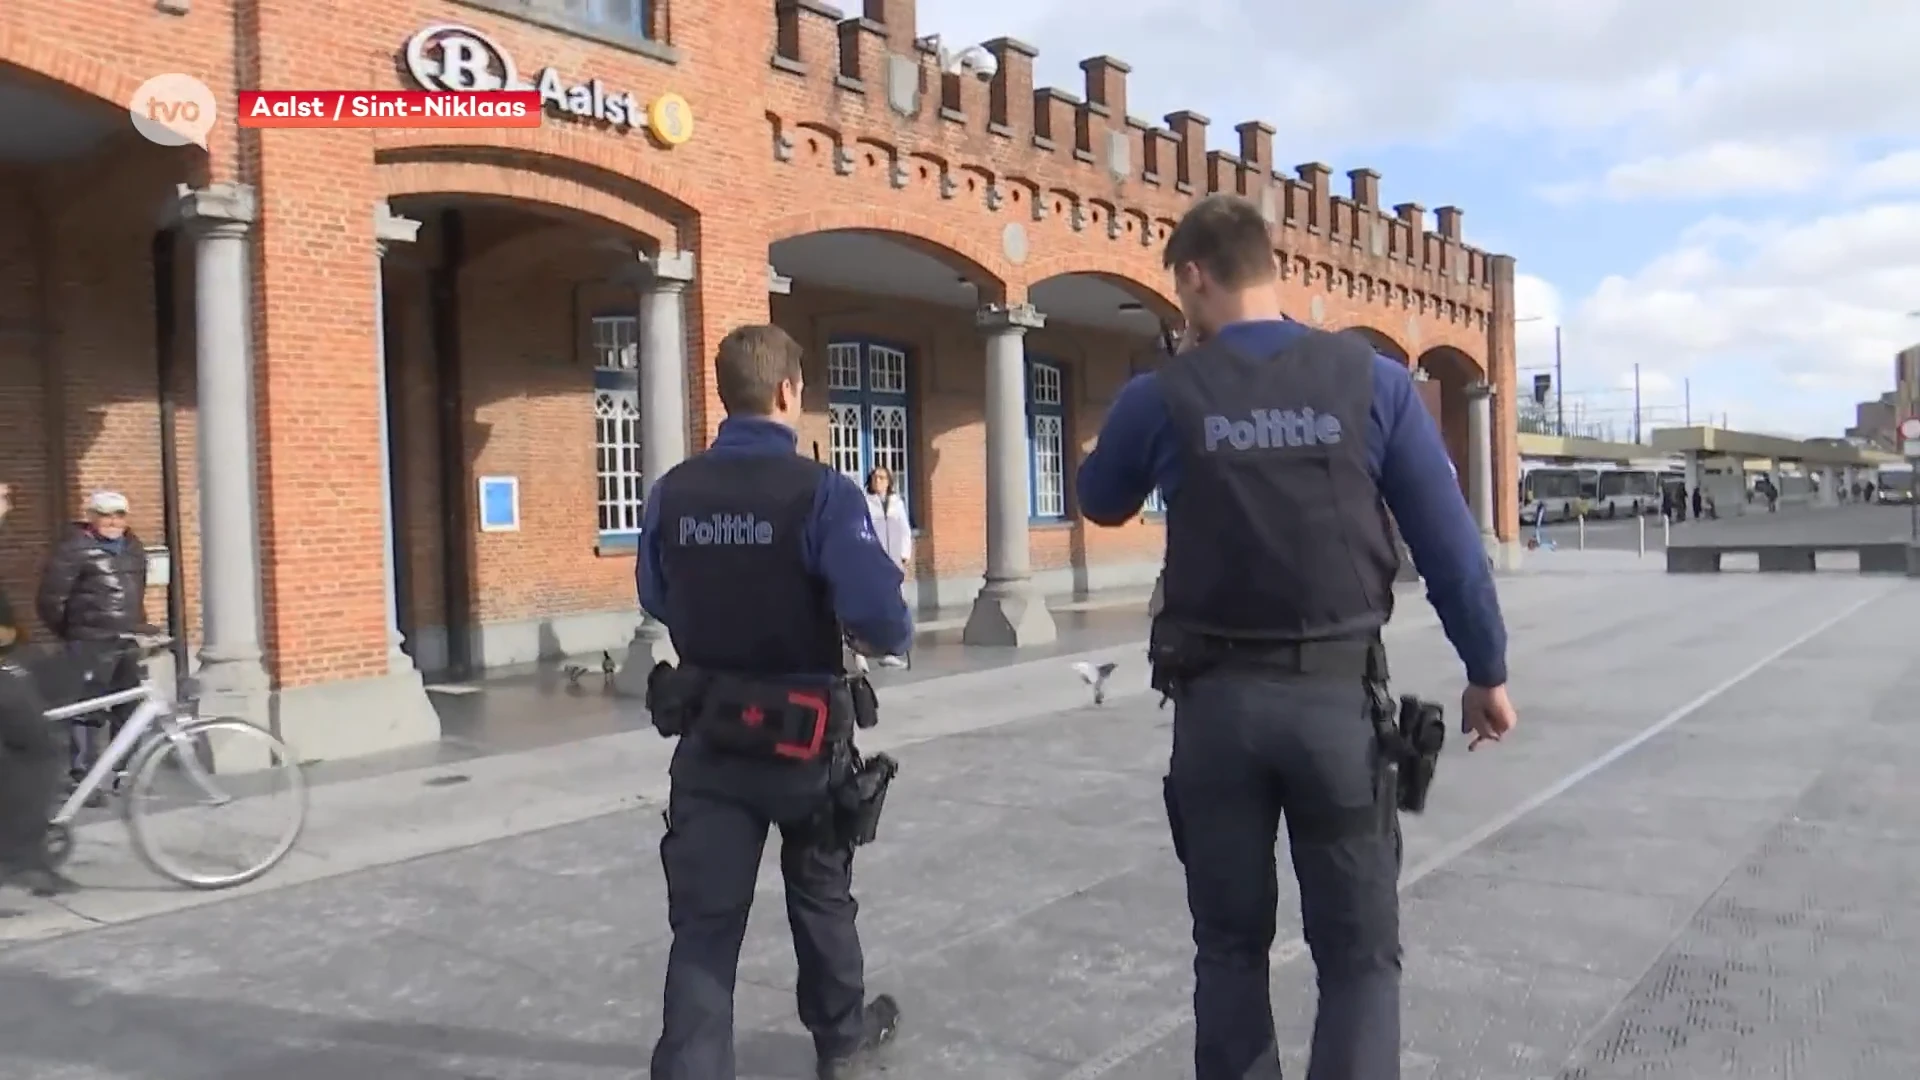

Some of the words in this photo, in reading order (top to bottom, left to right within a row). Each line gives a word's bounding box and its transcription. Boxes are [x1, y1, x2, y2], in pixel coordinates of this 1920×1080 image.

[538, 66, 642, 128] Aalst
[1203, 405, 1342, 452] Politie
[679, 511, 773, 545] Politie
